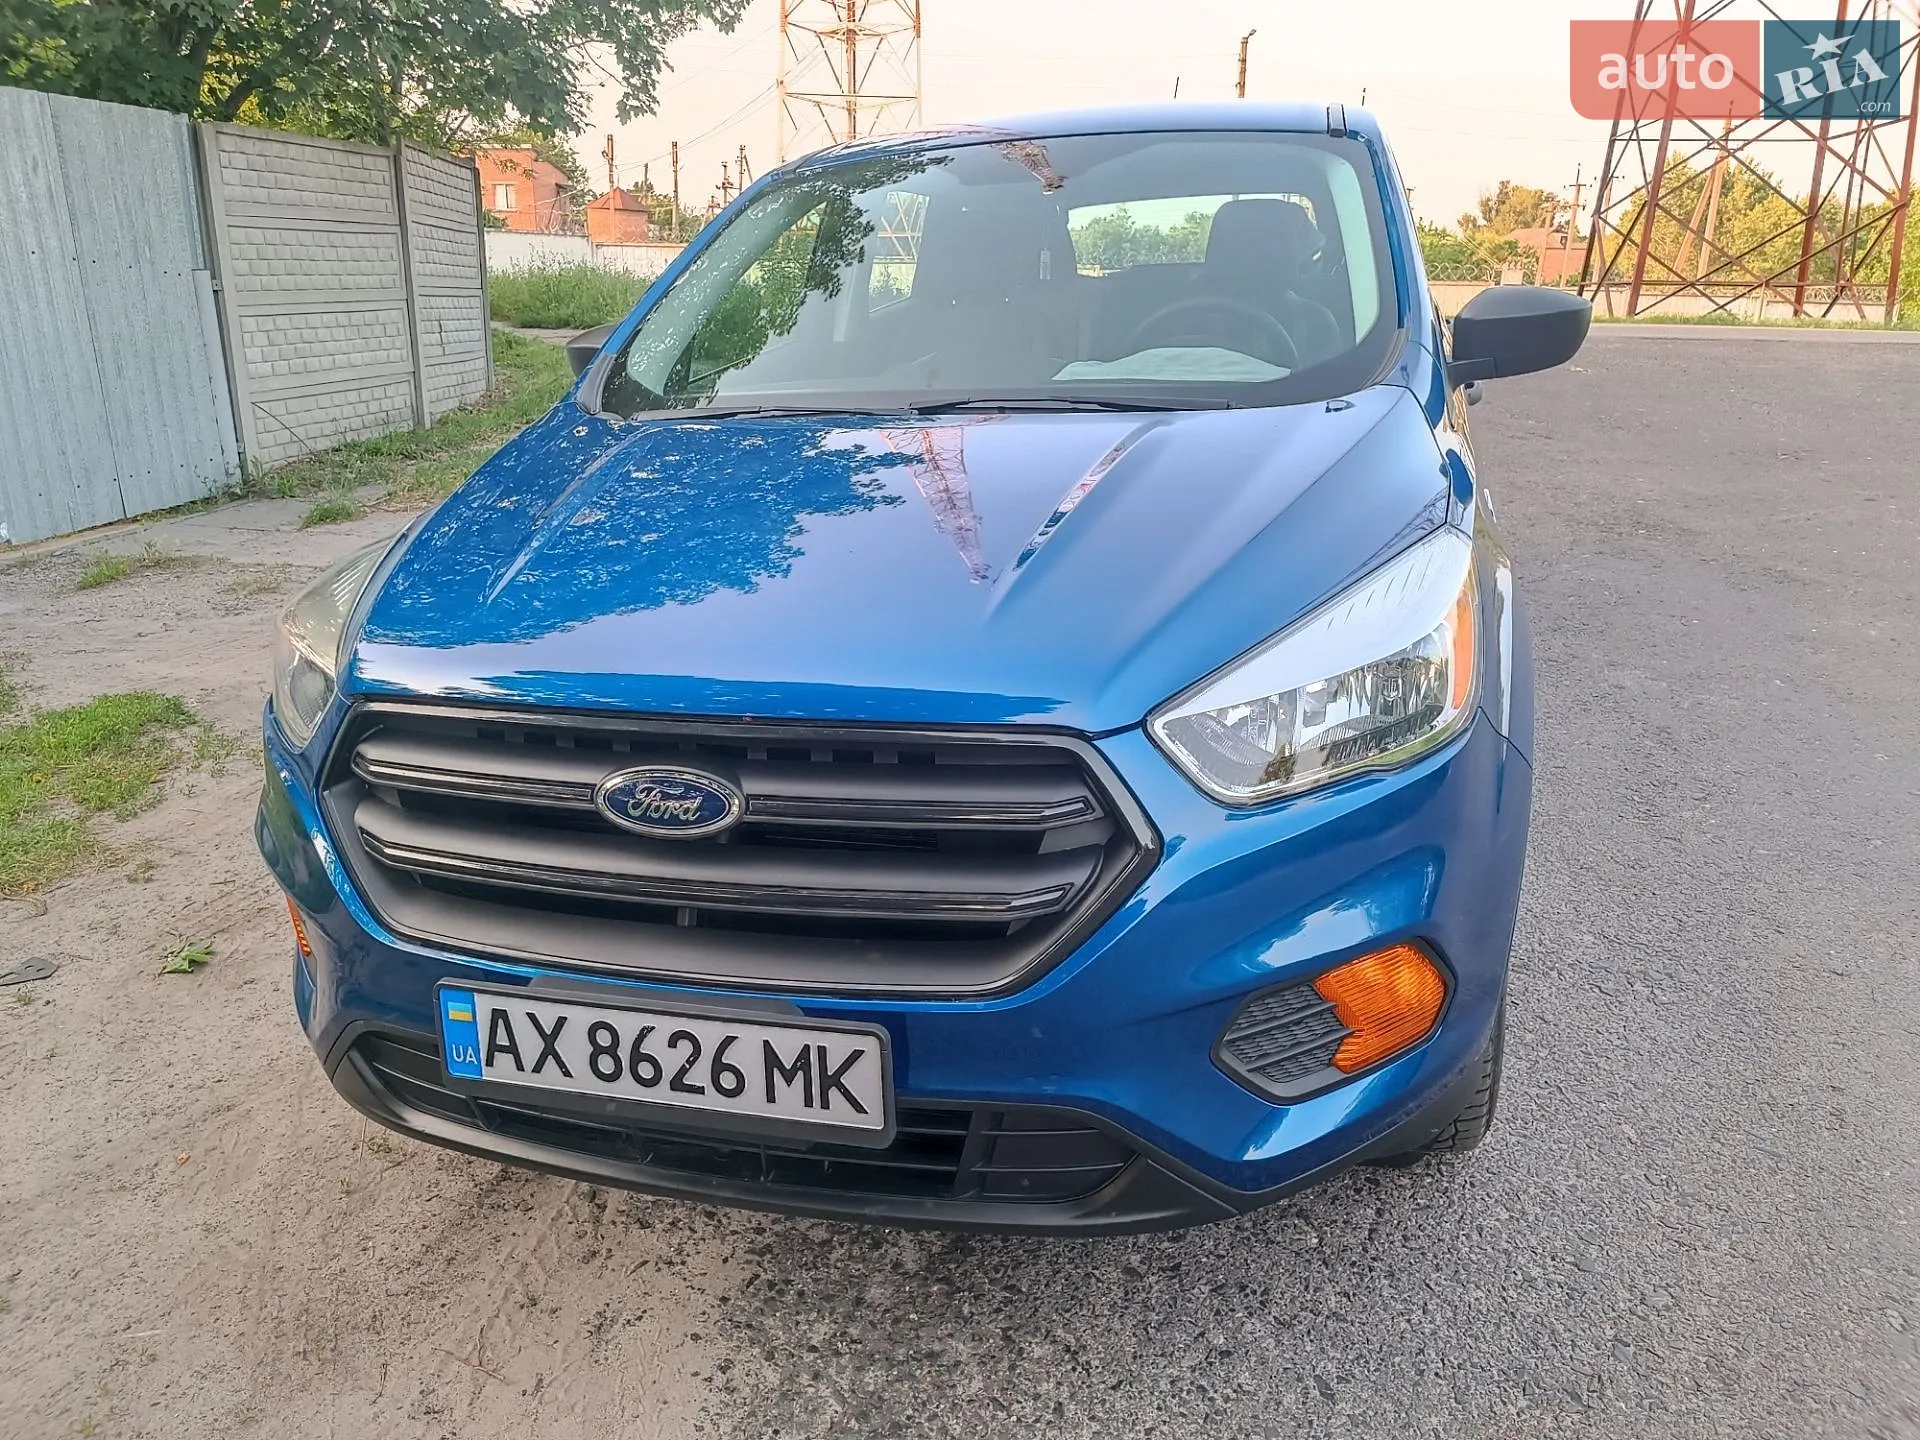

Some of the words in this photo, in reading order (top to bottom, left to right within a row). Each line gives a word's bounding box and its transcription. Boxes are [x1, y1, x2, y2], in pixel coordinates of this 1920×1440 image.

[627, 783, 703, 821] Ford
[452, 1047, 478, 1065] UA
[485, 1007, 573, 1079] AX
[587, 1020, 746, 1098] 8626
[762, 1038, 869, 1115] MK
